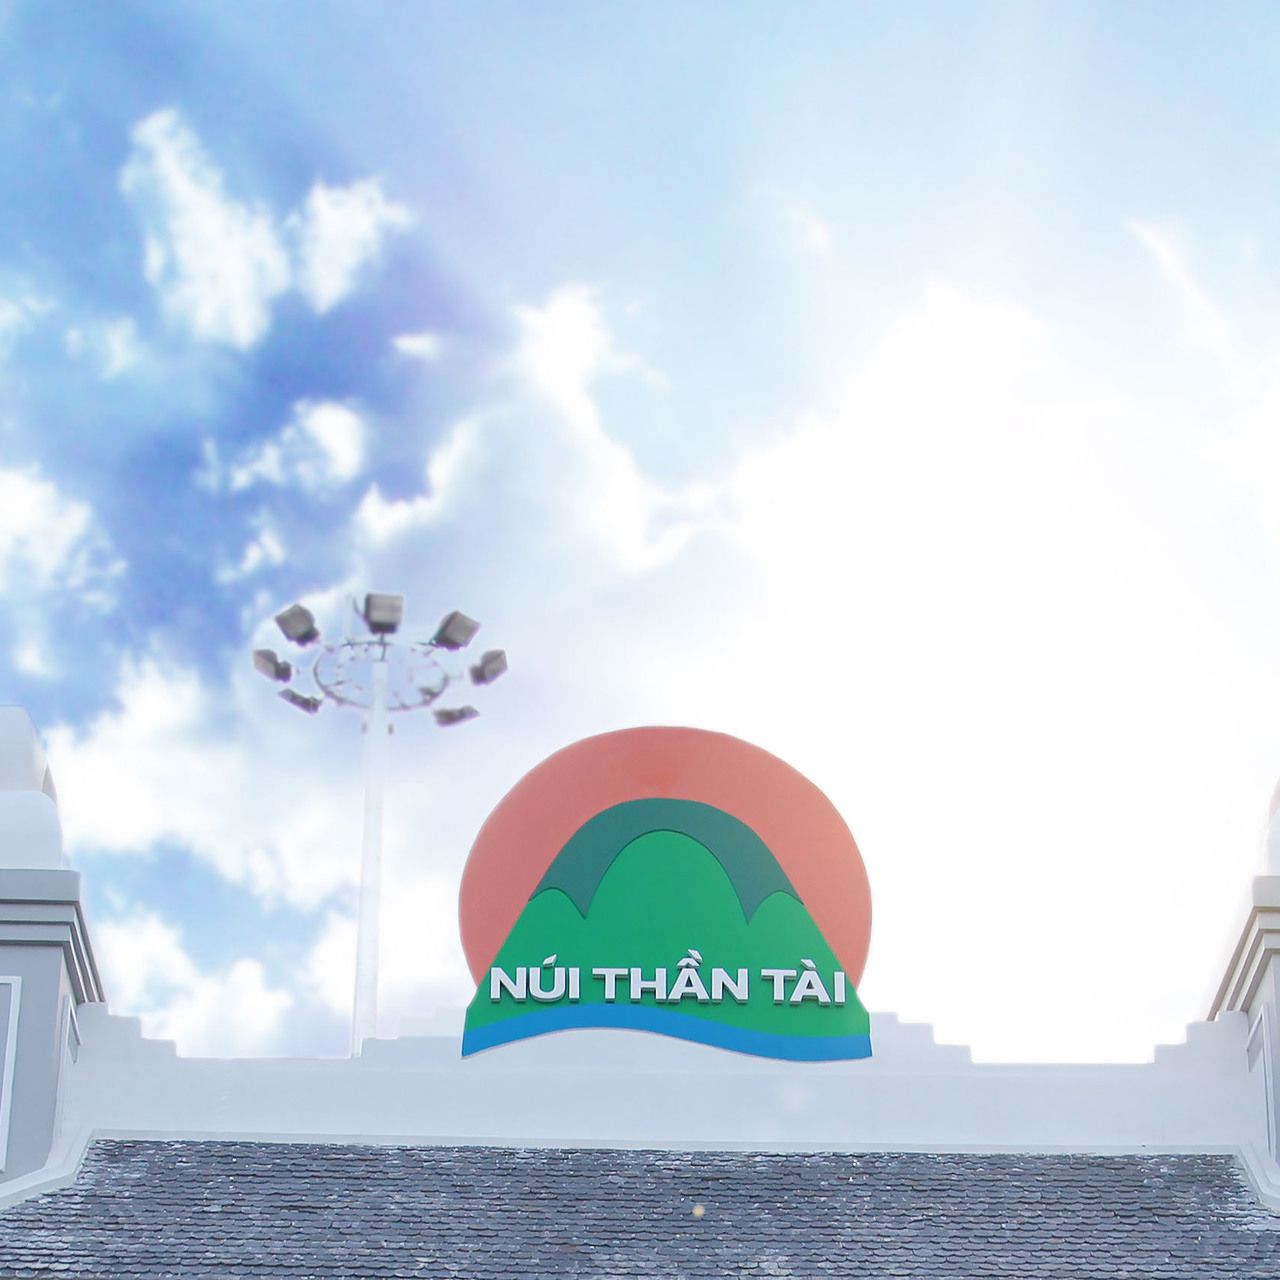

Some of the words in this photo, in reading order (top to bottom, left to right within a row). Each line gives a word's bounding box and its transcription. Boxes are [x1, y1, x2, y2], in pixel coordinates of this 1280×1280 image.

[490, 954, 580, 1002] NÚI
[592, 949, 749, 1003] THẦN
[760, 959, 846, 1005] TÀI
